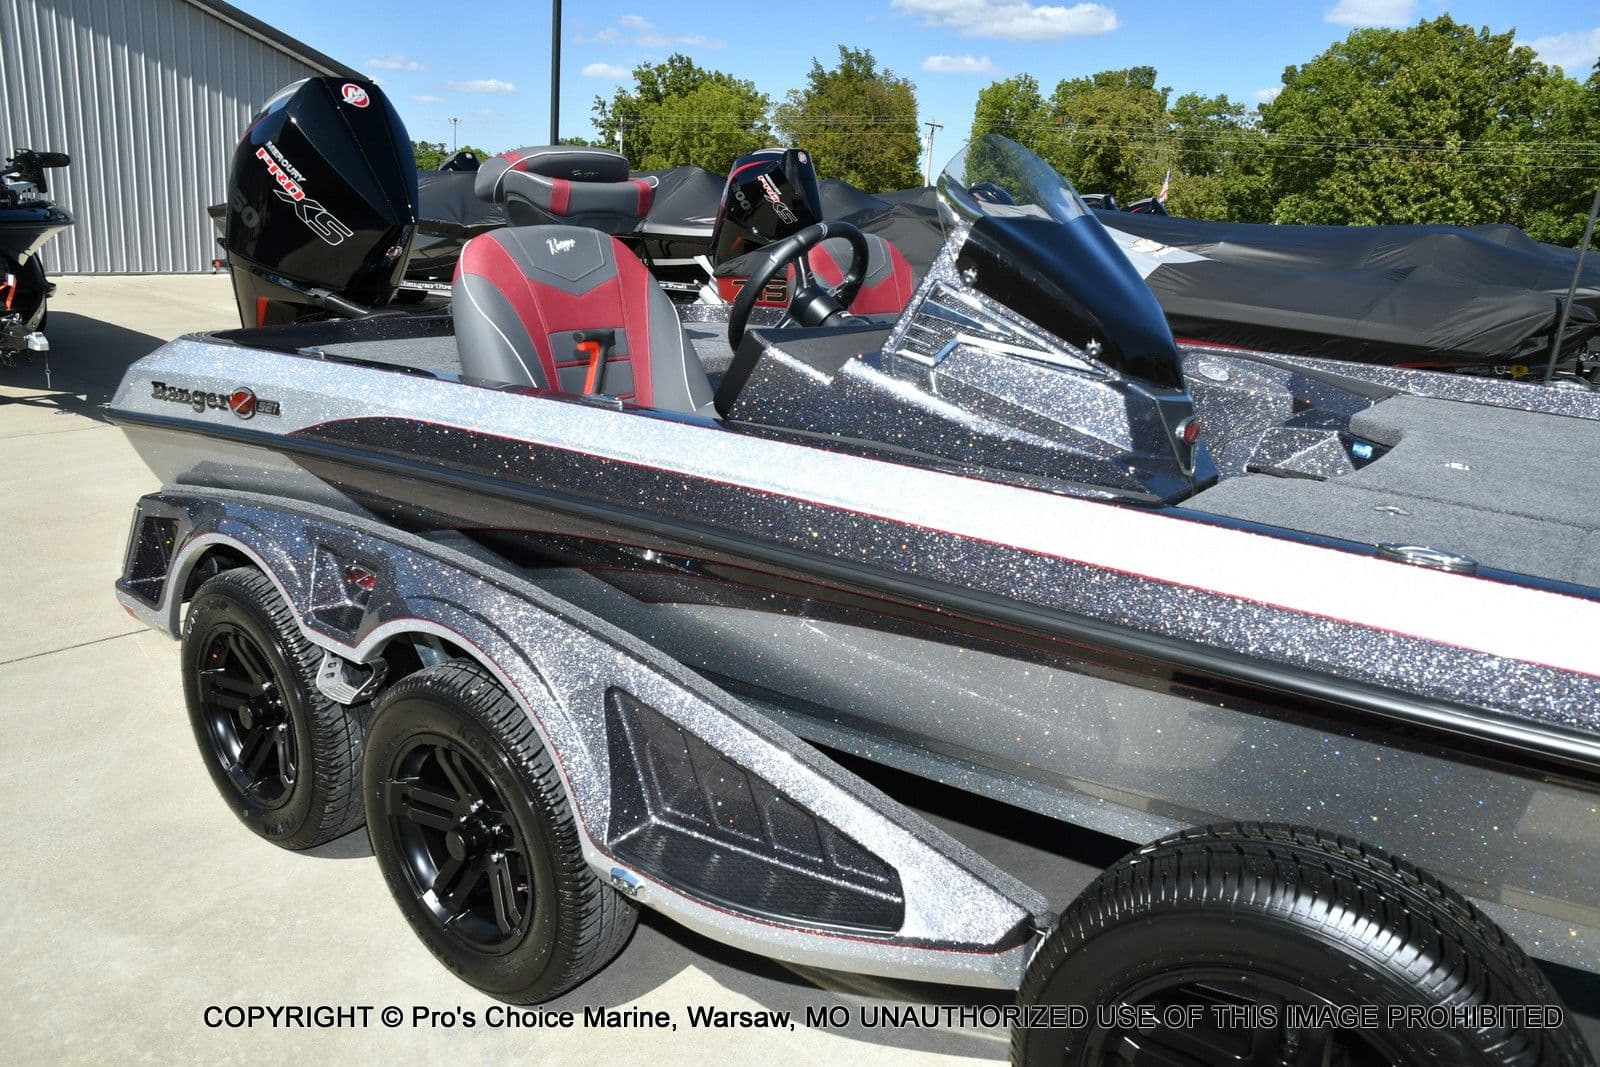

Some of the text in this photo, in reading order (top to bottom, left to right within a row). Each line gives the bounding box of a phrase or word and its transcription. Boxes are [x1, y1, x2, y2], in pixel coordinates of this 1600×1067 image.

[256, 147, 354, 246] PRO XS
[151, 380, 230, 414] Ranger
